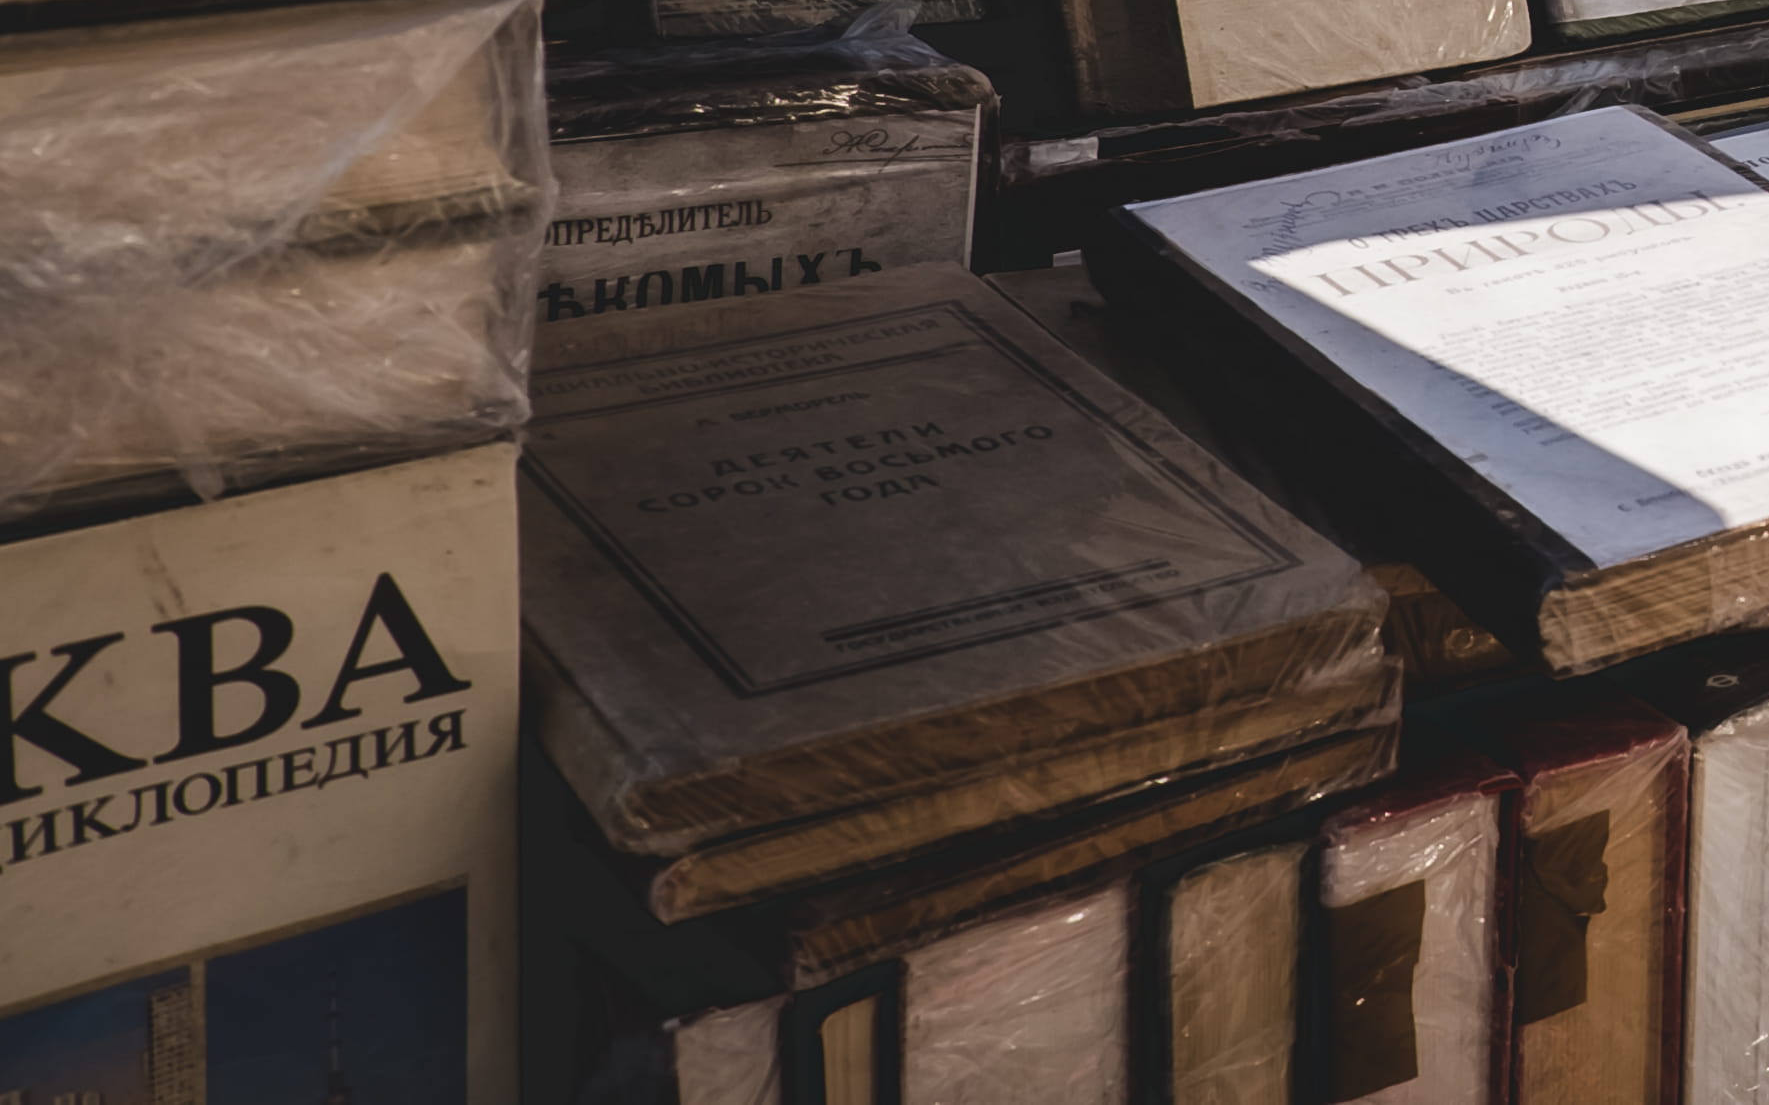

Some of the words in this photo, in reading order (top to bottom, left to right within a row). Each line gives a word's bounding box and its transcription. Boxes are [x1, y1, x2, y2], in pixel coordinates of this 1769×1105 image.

[637, 470, 800, 514] СОРОК
[815, 425, 1055, 485] ВОСЬМОГО
[709, 419, 945, 479] ДЕЯТЕЛИ
[818, 473, 939, 509] ГОДА
[0, 571, 472, 805] КВА
